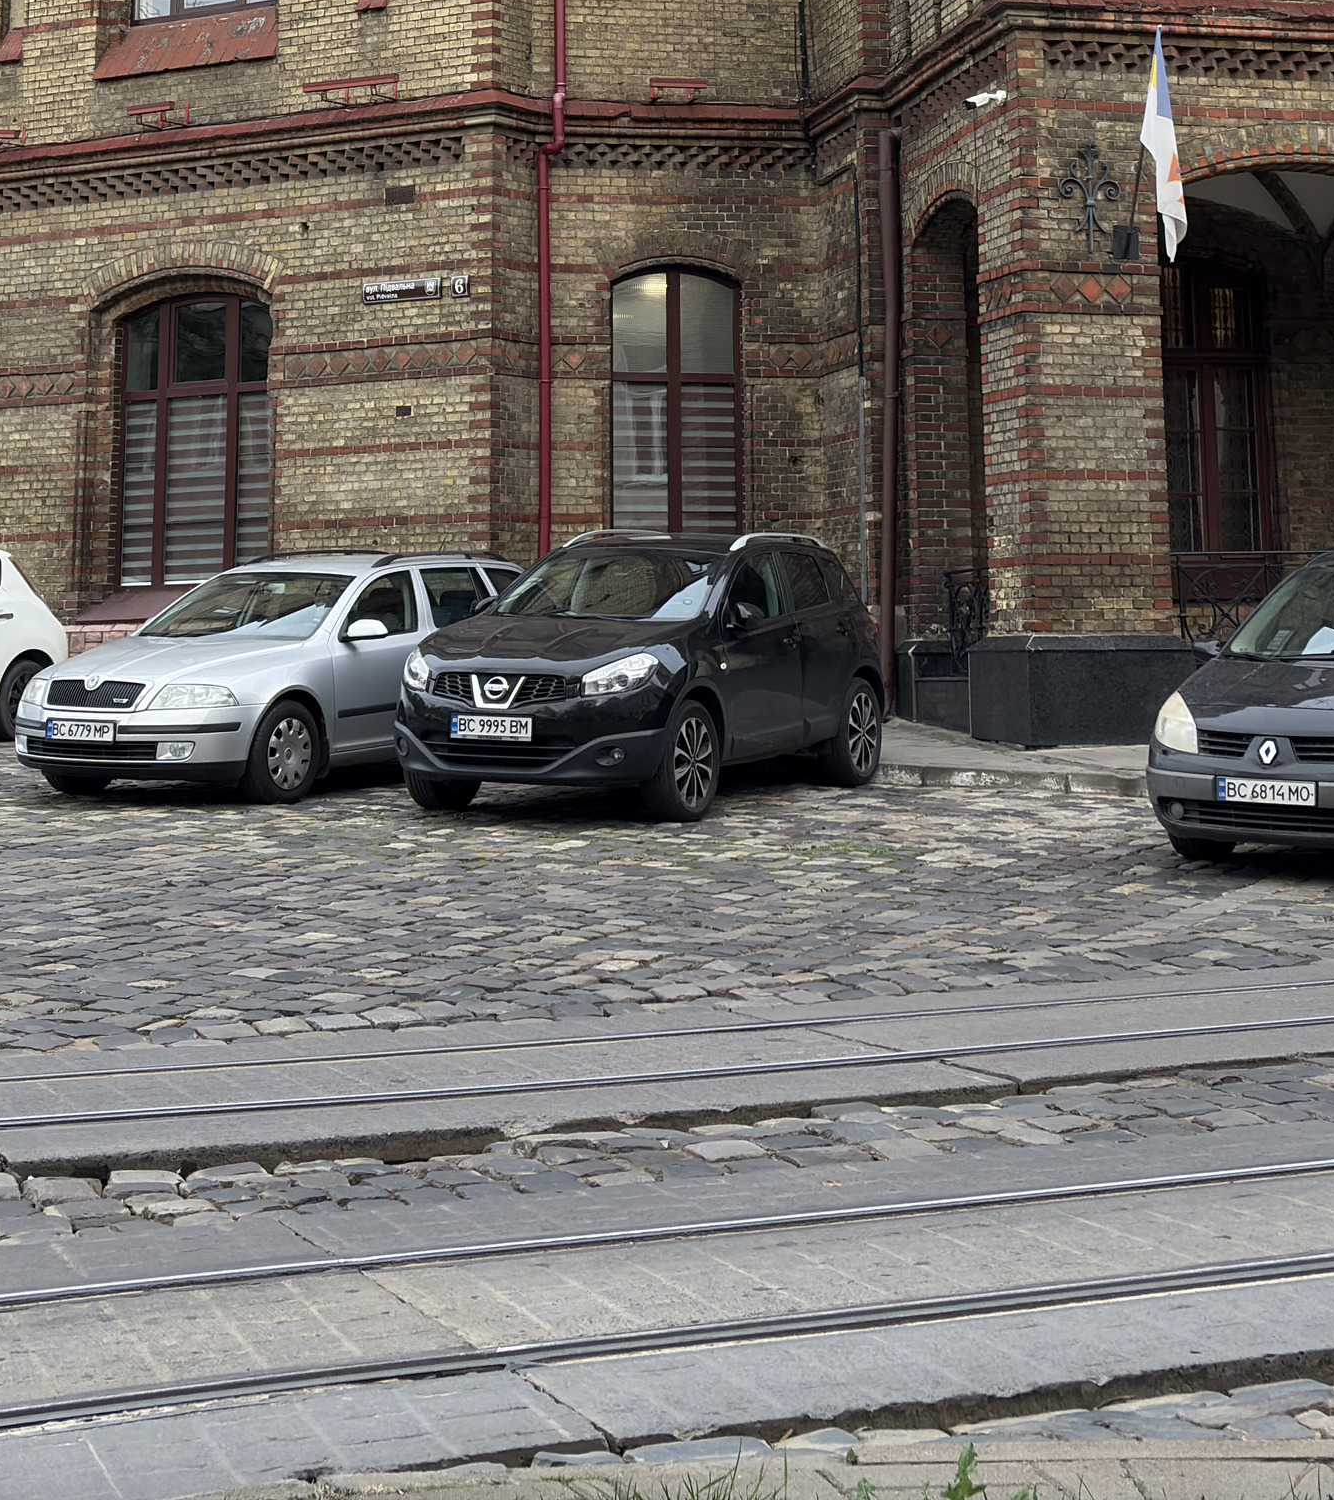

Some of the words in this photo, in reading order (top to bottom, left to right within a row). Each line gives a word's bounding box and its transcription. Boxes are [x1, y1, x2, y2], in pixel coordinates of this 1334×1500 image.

[365, 285, 379, 294] вул.
[380, 282, 415, 292] Підвальна
[454, 278, 464, 293] 6
[52, 723, 66, 737] BC
[67, 723, 92, 738] 6779
[93, 724, 110, 738] MP
[458, 718, 475, 732] BC
[478, 718, 507, 733] 9995
[509, 719, 528, 734] BM
[1227, 782, 1247, 798] BC
[1251, 783, 1285, 801] 6814
[1288, 785, 1310, 802] MO
